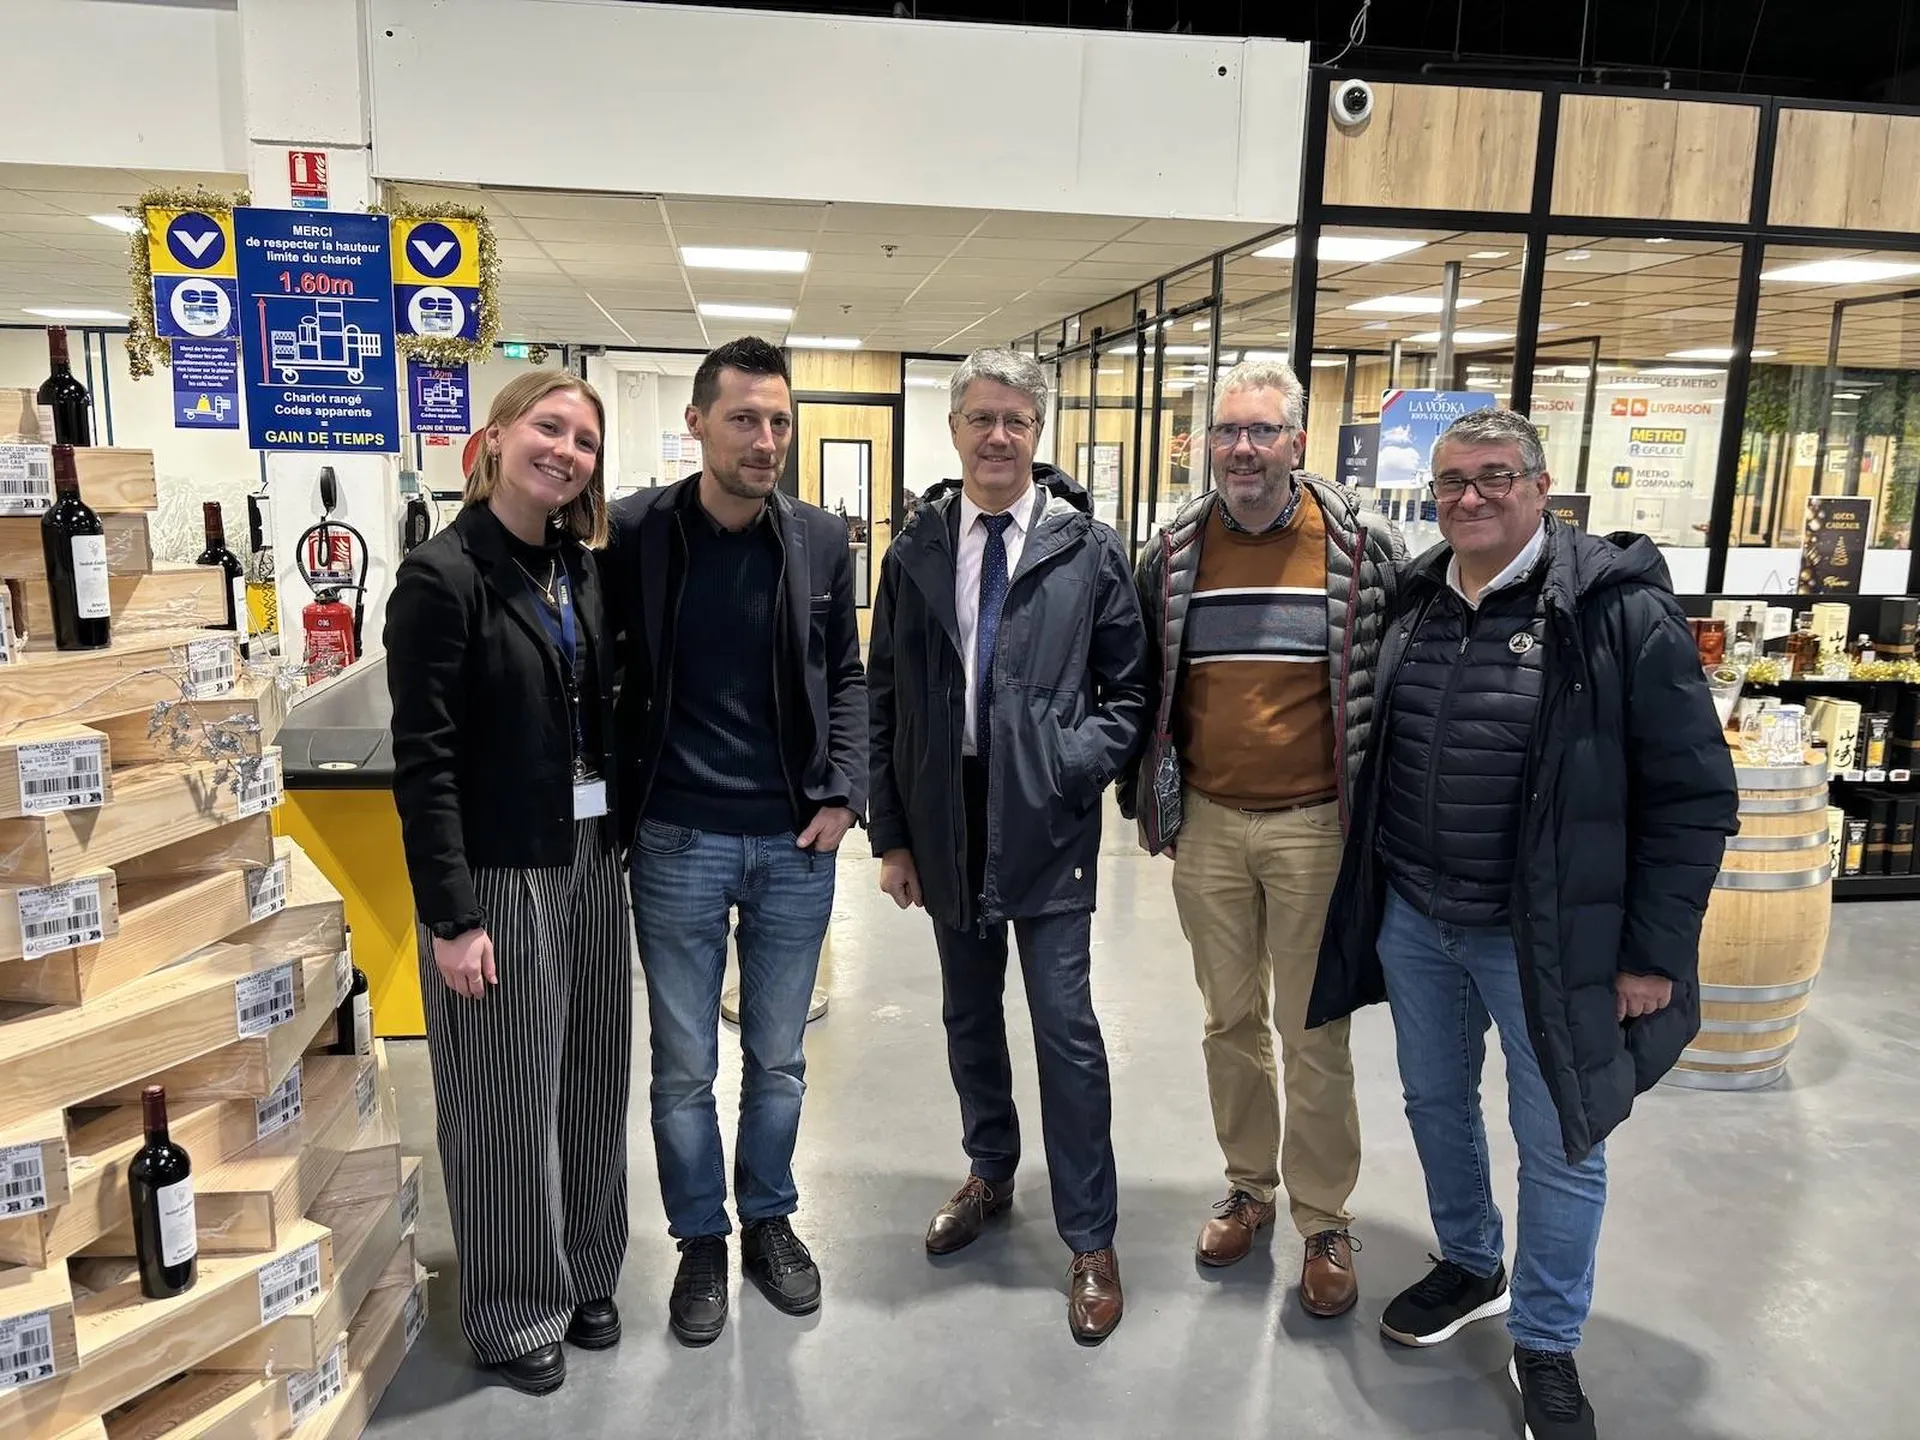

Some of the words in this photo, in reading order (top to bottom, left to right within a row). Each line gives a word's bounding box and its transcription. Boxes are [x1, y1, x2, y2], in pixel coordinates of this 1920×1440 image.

[292, 226, 332, 237] MERCI
[246, 237, 260, 247] de
[264, 239, 319, 250] respecter
[323, 240, 332, 250] la
[336, 241, 380, 253] hauteur
[267, 251, 299, 262] limite
[302, 252, 317, 263] du
[321, 254, 361, 265] chariot
[279, 271, 354, 295] 1.60m
[1681, 379, 1717, 389] METRO
[283, 392, 326, 403] Chariot
[330, 394, 362, 406] rangé
[275, 404, 312, 415] Codes
[315, 408, 372, 418] apparents
[1409, 401, 1423, 412] LA
[1427, 401, 1465, 414] VODKA
[1651, 403, 1711, 414] LIVRAISON
[265, 431, 302, 443] GAIN
[308, 432, 329, 444] DE
[333, 433, 385, 445] TEMPS
[1632, 429, 1684, 442] METRO
[1636, 470, 1670, 478] METRO
[1635, 480, 1694, 489] COMPANION
